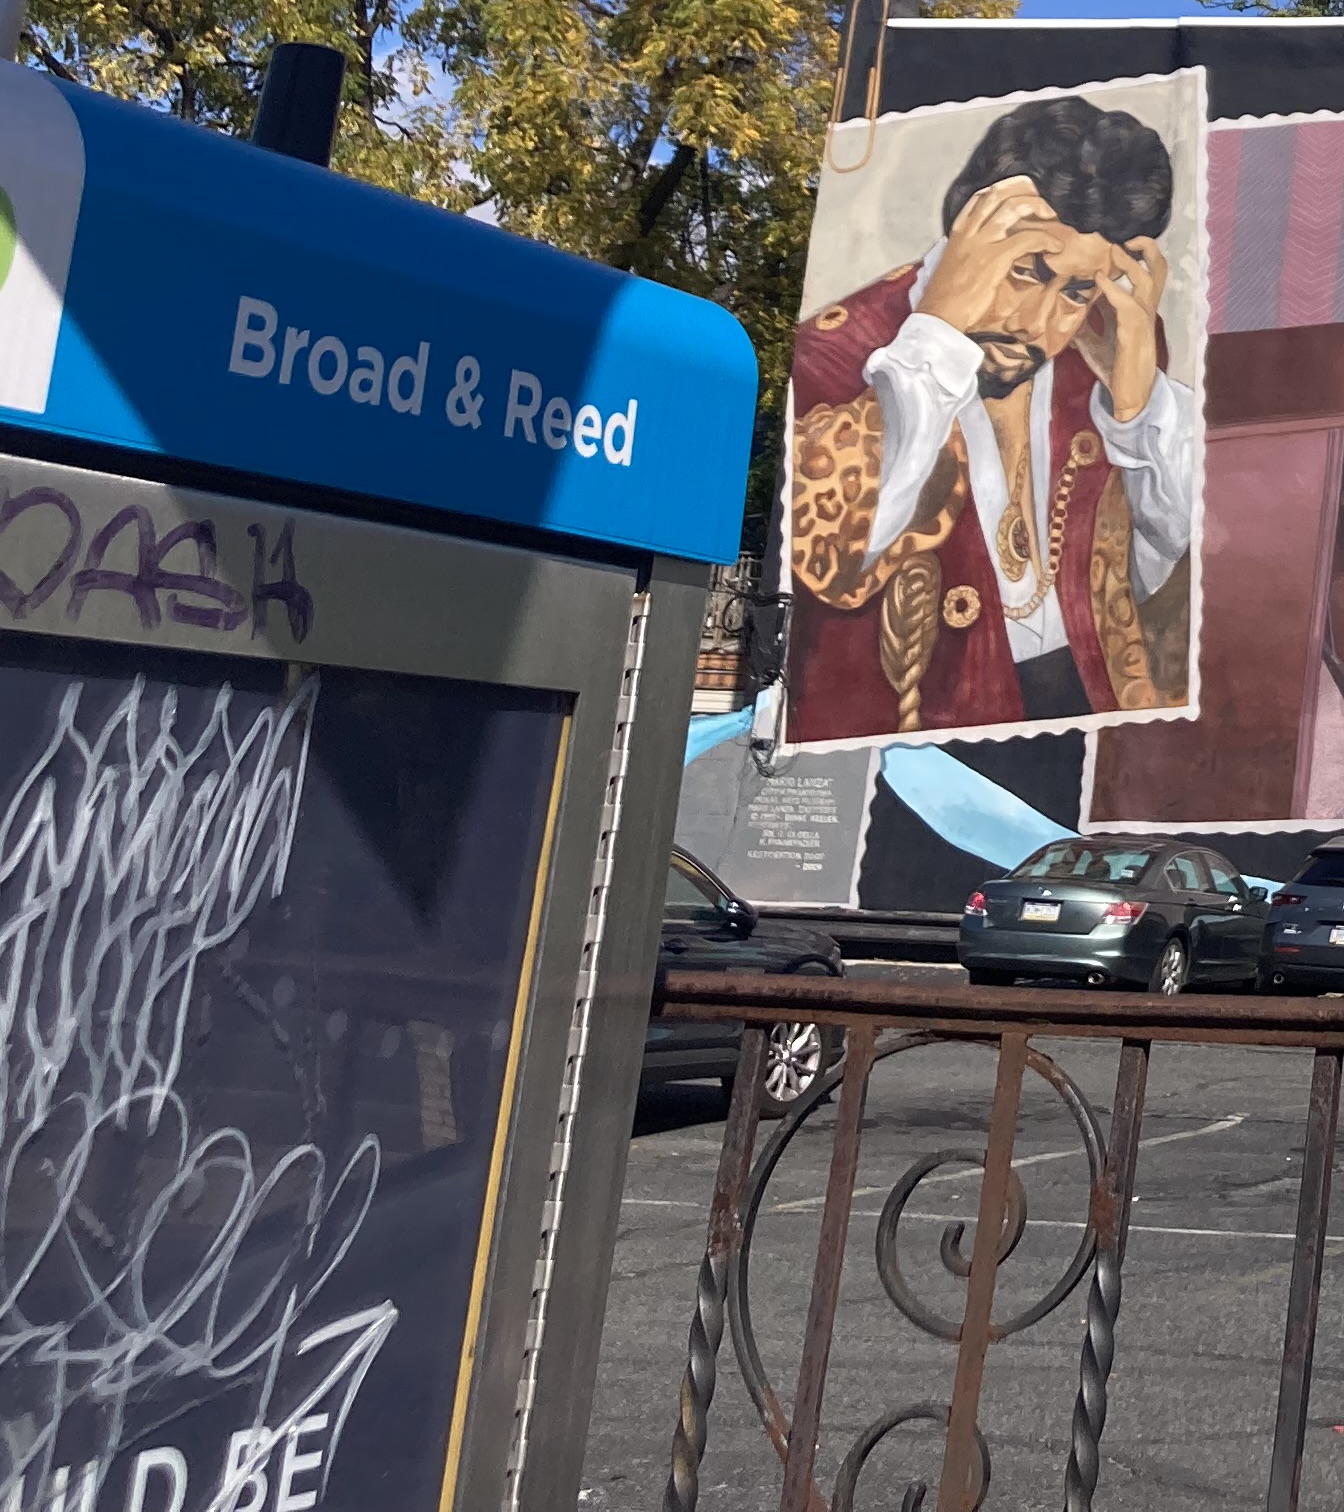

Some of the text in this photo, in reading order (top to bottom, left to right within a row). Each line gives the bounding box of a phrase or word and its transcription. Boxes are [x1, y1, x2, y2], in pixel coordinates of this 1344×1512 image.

[228, 295, 639, 467] Broad & Reed
